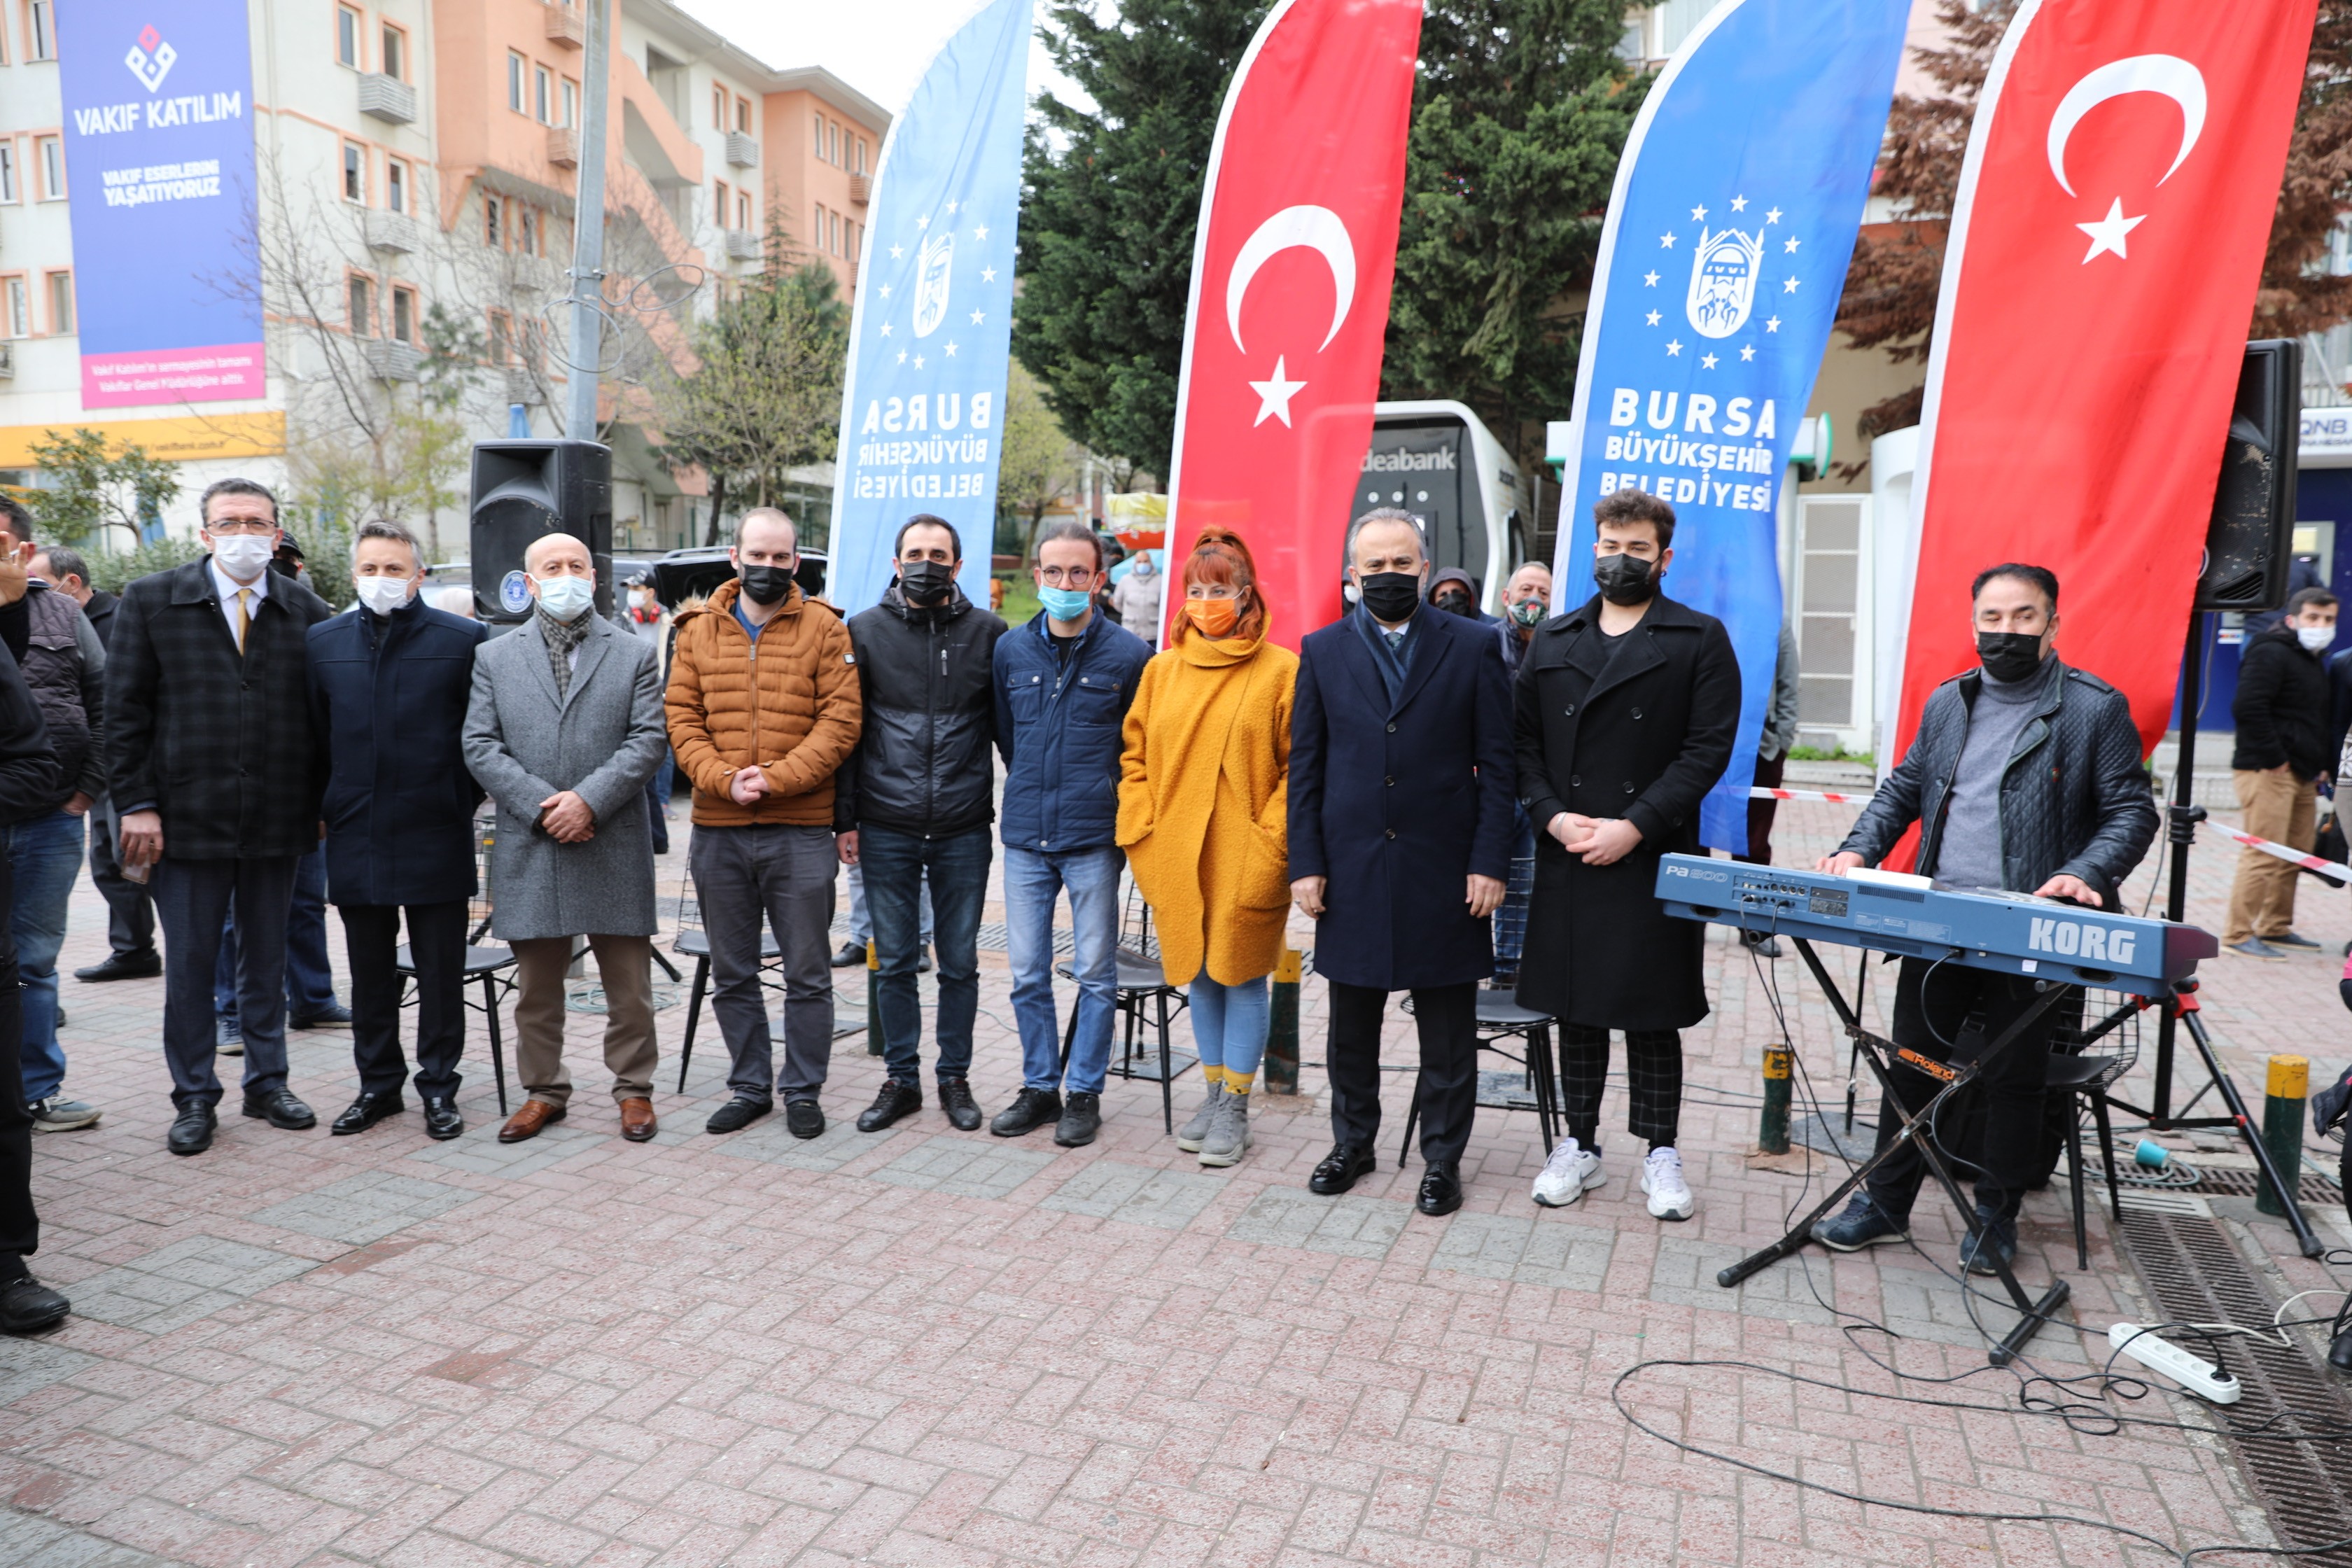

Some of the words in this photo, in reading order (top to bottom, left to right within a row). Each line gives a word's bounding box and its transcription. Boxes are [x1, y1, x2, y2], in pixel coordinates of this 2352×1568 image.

[74, 103, 140, 136] VAKIF
[146, 90, 241, 129] KATILIM
[102, 168, 143, 187] VAKIF
[103, 176, 221, 207] YAŞATIYORUZ
[1609, 387, 1776, 439] BURSA
[1359, 444, 1457, 472] deabank
[1604, 430, 1774, 475] BÜYÜKŞEHİR
[2029, 916, 2136, 965] KORG
